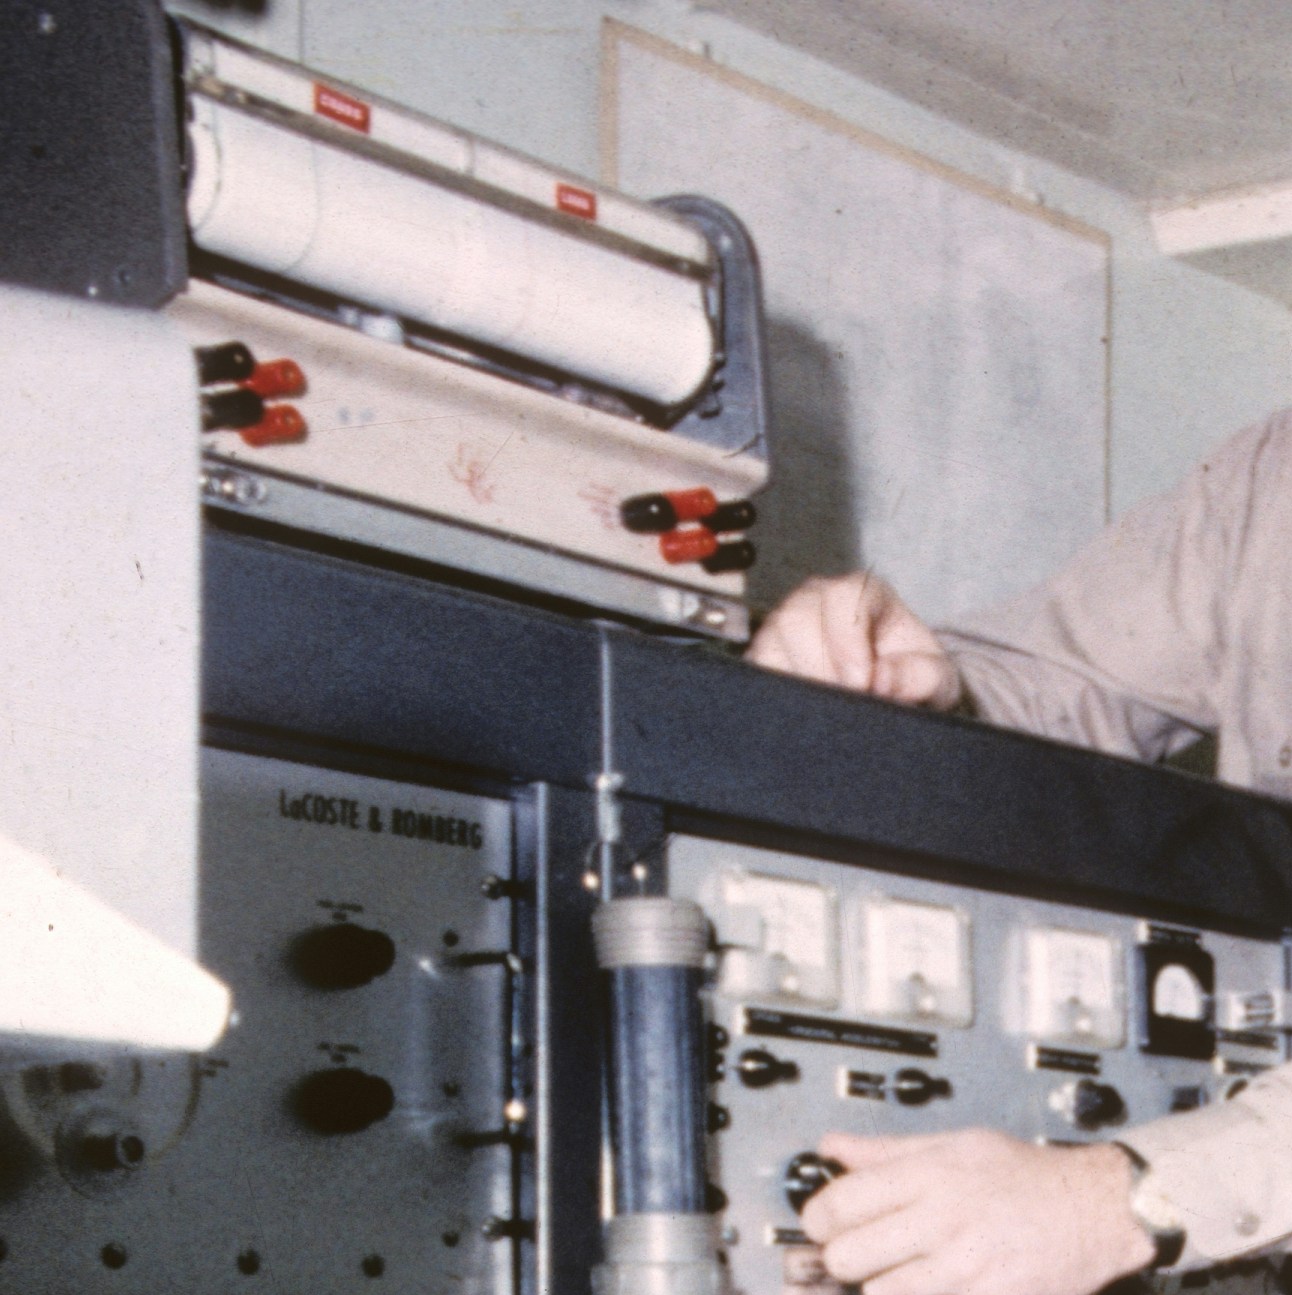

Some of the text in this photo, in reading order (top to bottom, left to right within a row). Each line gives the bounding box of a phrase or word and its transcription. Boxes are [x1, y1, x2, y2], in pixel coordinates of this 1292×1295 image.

[279, 788, 484, 850] LaCOSTE & ROMBERG
